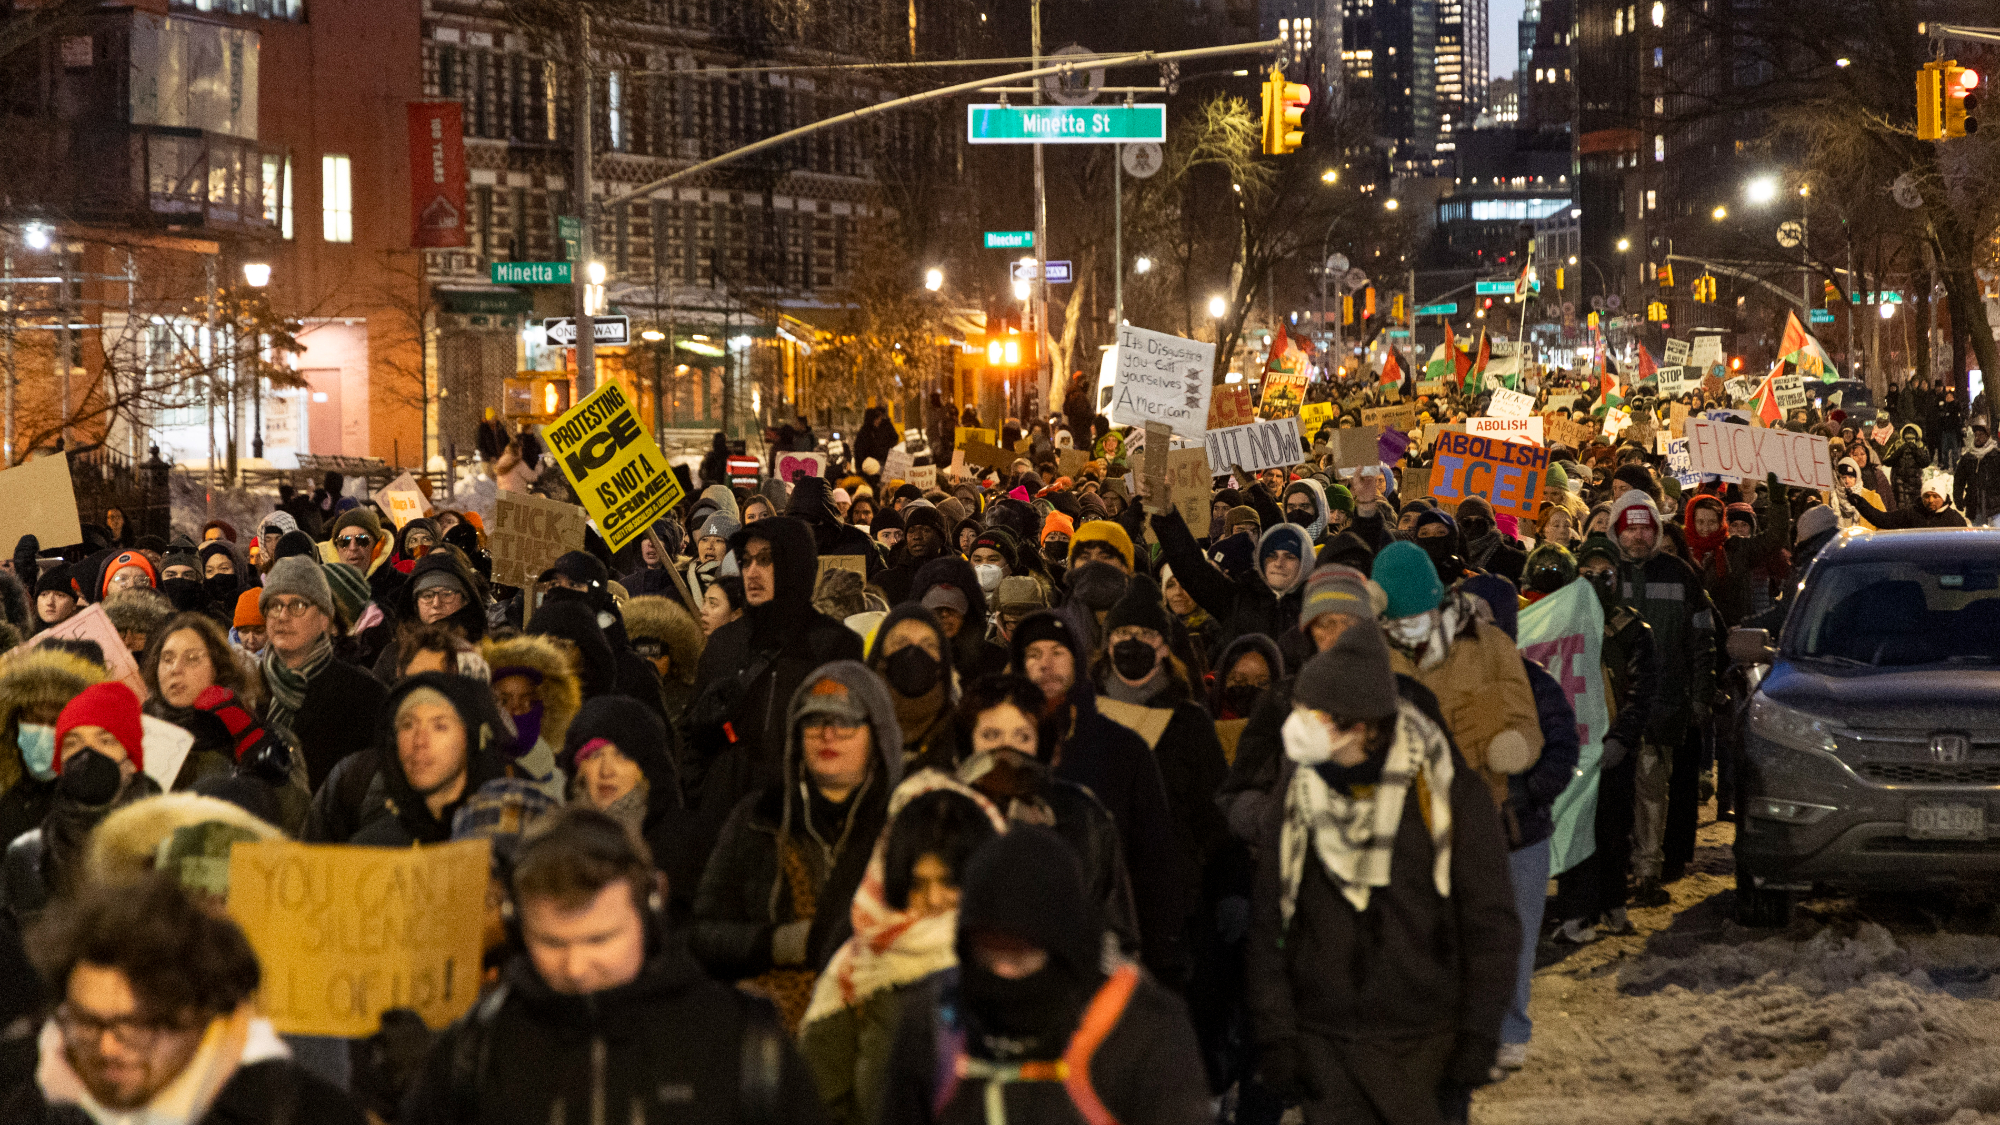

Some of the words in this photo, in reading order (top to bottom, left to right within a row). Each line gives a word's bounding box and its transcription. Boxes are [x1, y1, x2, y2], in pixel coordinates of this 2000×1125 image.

[1023, 113, 1085, 133] Minetta
[1092, 113, 1110, 133] St
[433, 142, 445, 184] YEARS
[987, 233, 1023, 247] Bleecker
[497, 263, 553, 281] Minetta
[557, 264, 568, 276] St
[555, 326, 577, 338] ONE
[594, 325, 620, 336] WAY
[1123, 352, 1148, 368] you
[1147, 338, 1203, 362] Disgusting
[1120, 370, 1182, 390] yourselves
[1659, 369, 1682, 384] STOP
[1115, 385, 1191, 419] American
[1274, 399, 1288, 407] ICE
[1495, 389, 1519, 403] FUCK
[549, 385, 626, 454] PROTESTING
[1476, 420, 1528, 431] ABOLISH
[564, 409, 642, 483] ICE
[1247, 421, 1300, 469] NOW
[1559, 432, 1574, 444] ICE
[1668, 441, 1686, 455] ICE
[1438, 432, 1550, 469] ABOLISH
[1695, 424, 1769, 476] FUCK
[1776, 433, 1830, 488] ICE
[595, 481, 619, 510] IS
[611, 459, 645, 499] NOT
[638, 453, 656, 478] A
[1433, 455, 1538, 511] ICE!
[602, 469, 672, 531] CRIME!
[496, 500, 564, 543] FUCK
[252, 857, 334, 916] YOU
